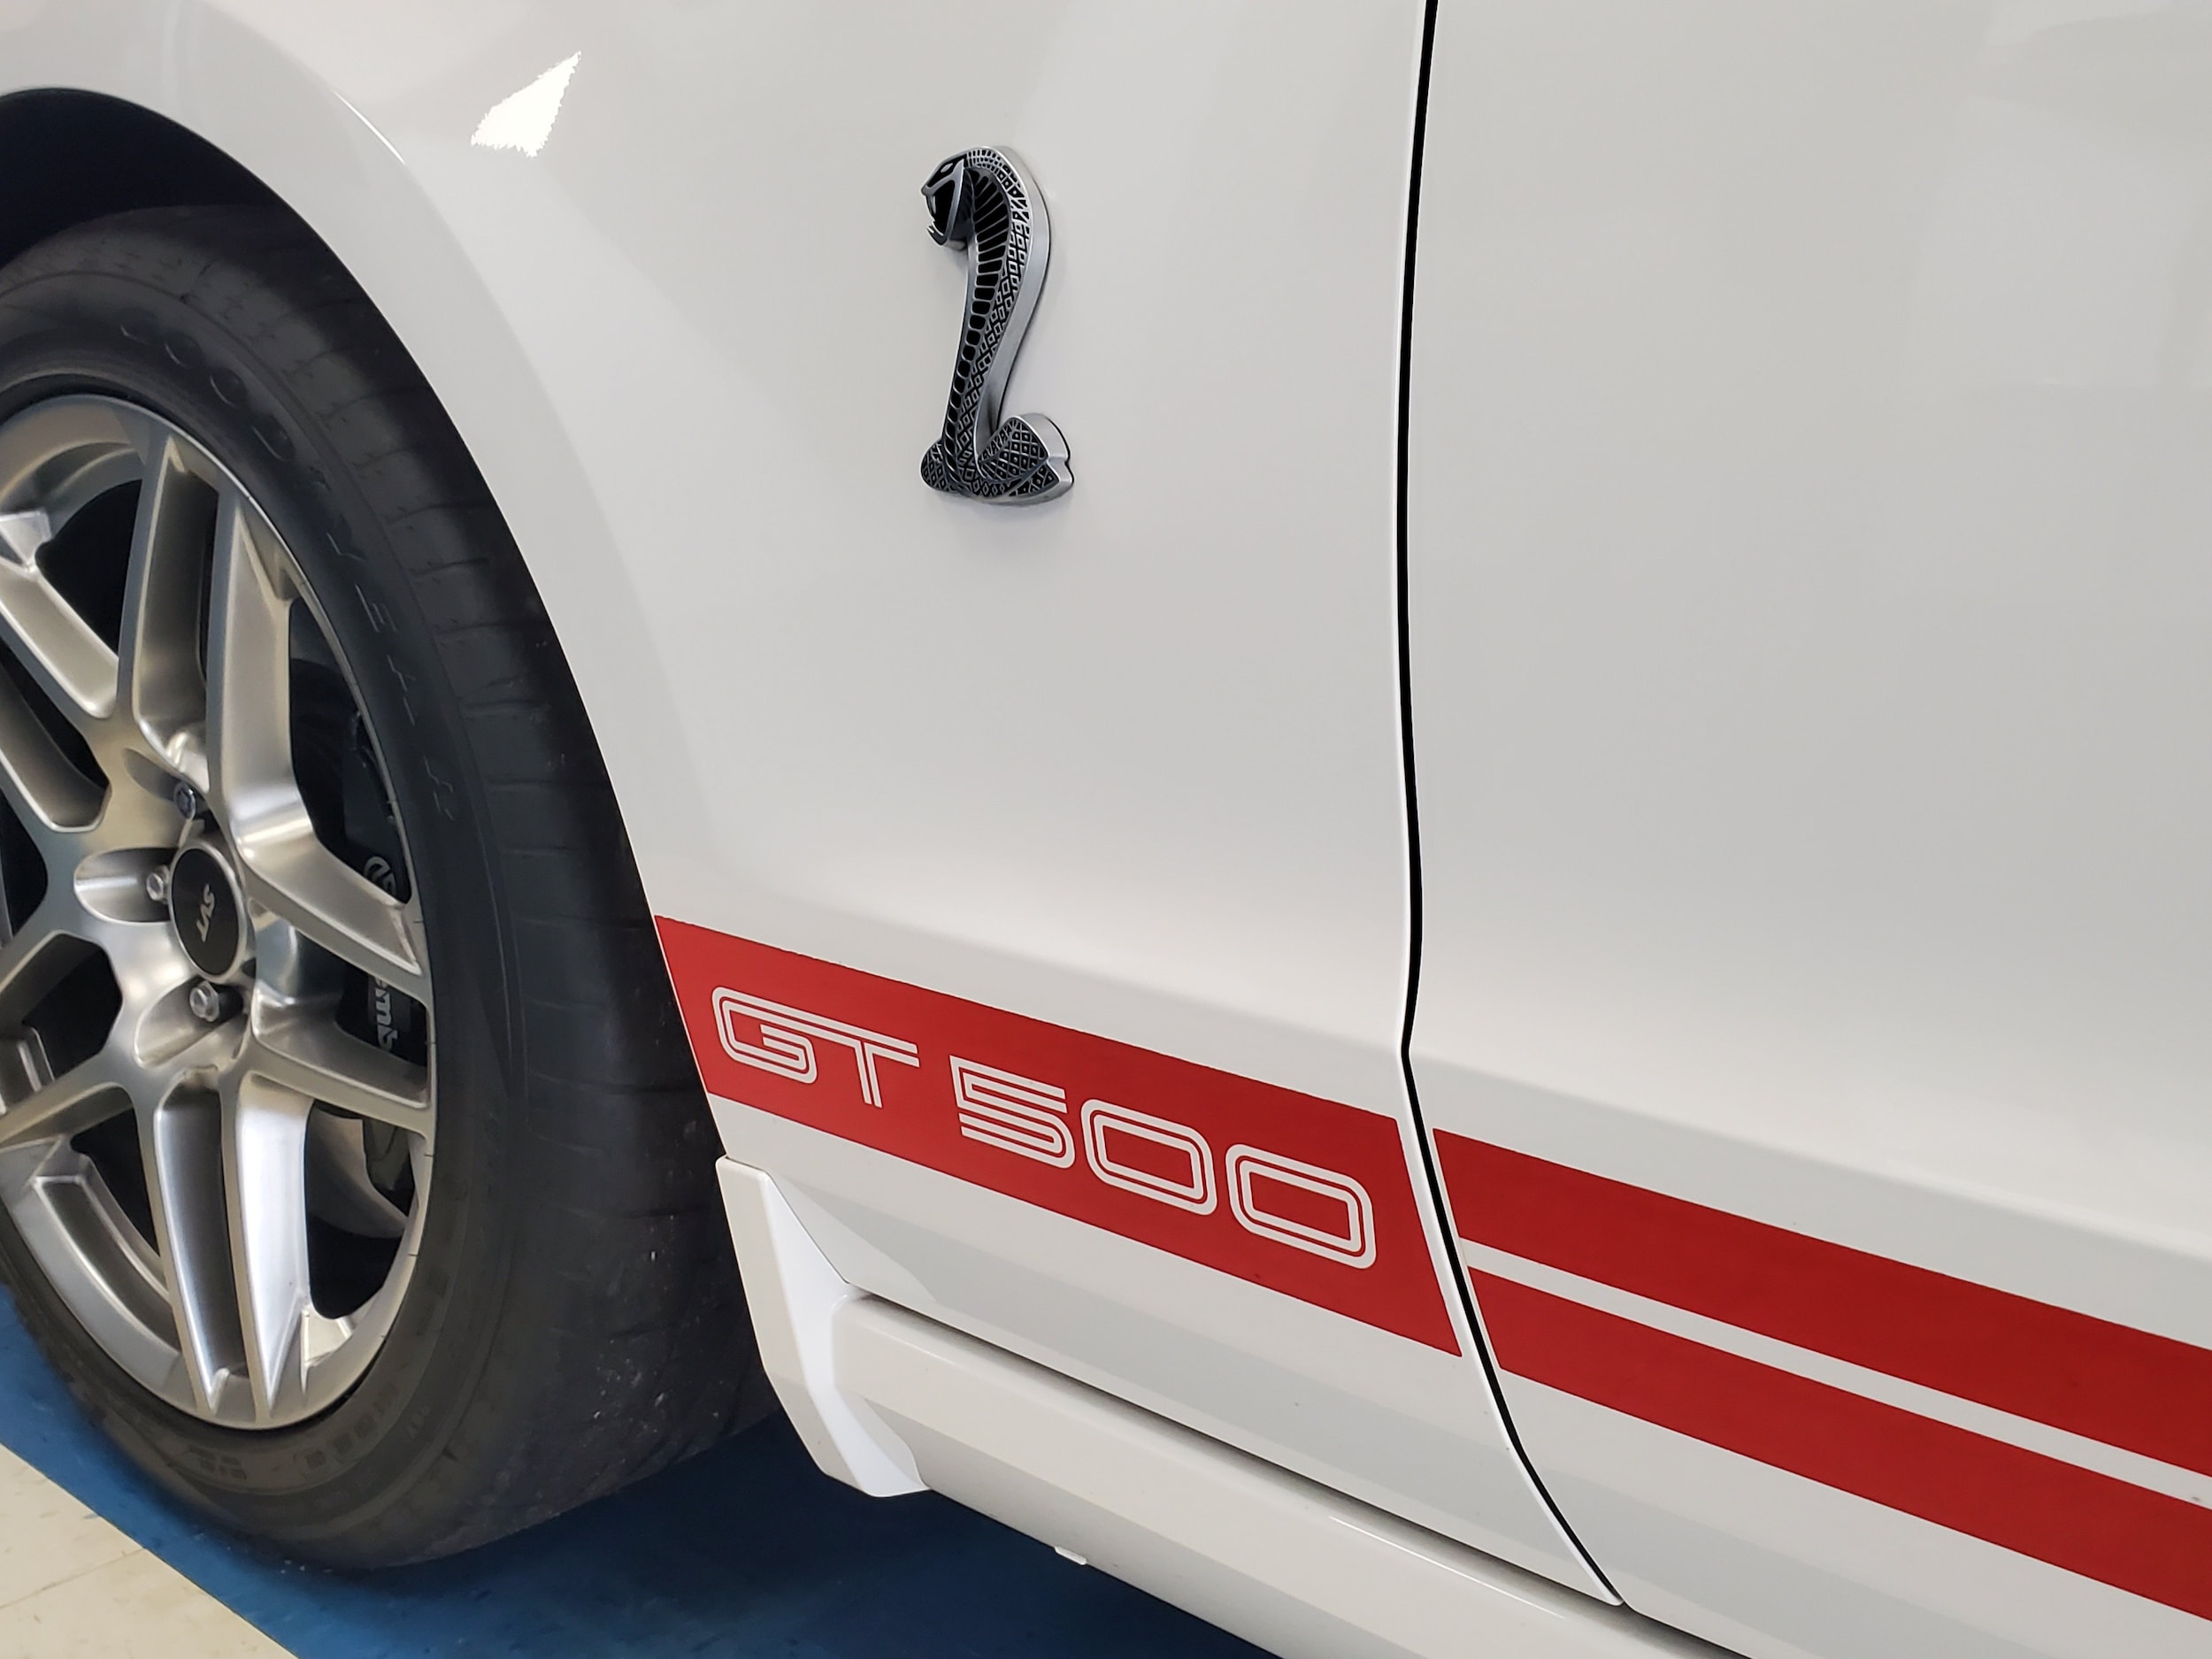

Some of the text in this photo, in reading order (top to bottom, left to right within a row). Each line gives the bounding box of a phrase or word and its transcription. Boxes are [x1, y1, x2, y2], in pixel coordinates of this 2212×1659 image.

[196, 883, 215, 942] SVT
[711, 986, 1377, 1269] GT 500
